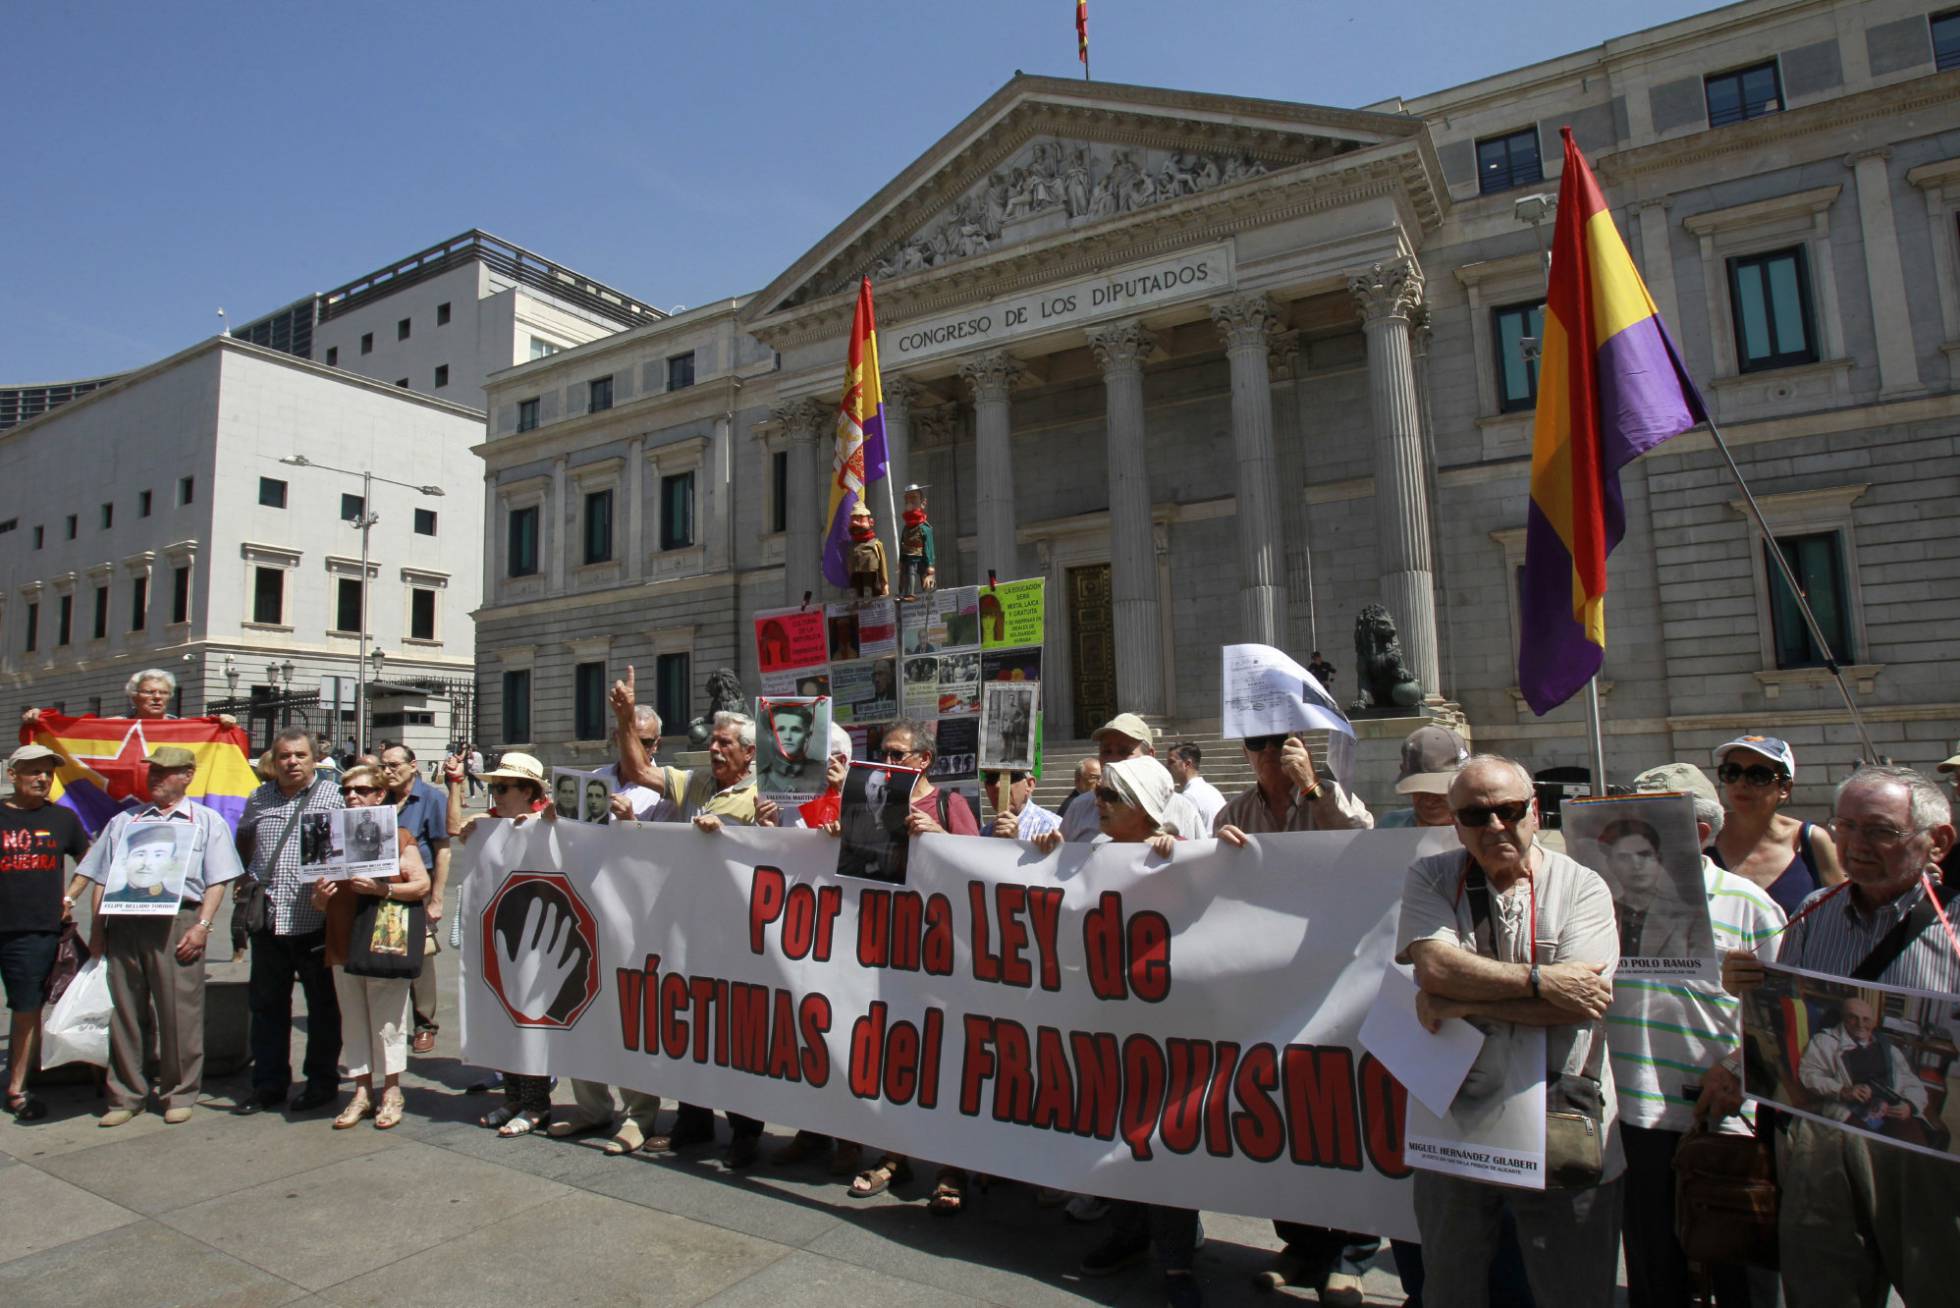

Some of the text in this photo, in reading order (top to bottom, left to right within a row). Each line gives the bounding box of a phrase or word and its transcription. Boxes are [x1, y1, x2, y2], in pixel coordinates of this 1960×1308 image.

[899, 263, 1209, 353] CONGRESO DE LOS DIPUTADOS
[2, 828, 32, 850] NO
[0, 854, 57, 872] GUERRA
[749, 865, 1171, 1003] Por una LEY de
[1631, 958, 1660, 968] POLO
[1663, 958, 1702, 969] RAMOS
[616, 953, 1415, 1179] VÍCTIMAS del FRANQUISMO
[1408, 1141, 1437, 1154] MIGUEL
[1440, 1147, 1490, 1162] HERNÁNDEZ
[1493, 1155, 1538, 1171] GILABERT
